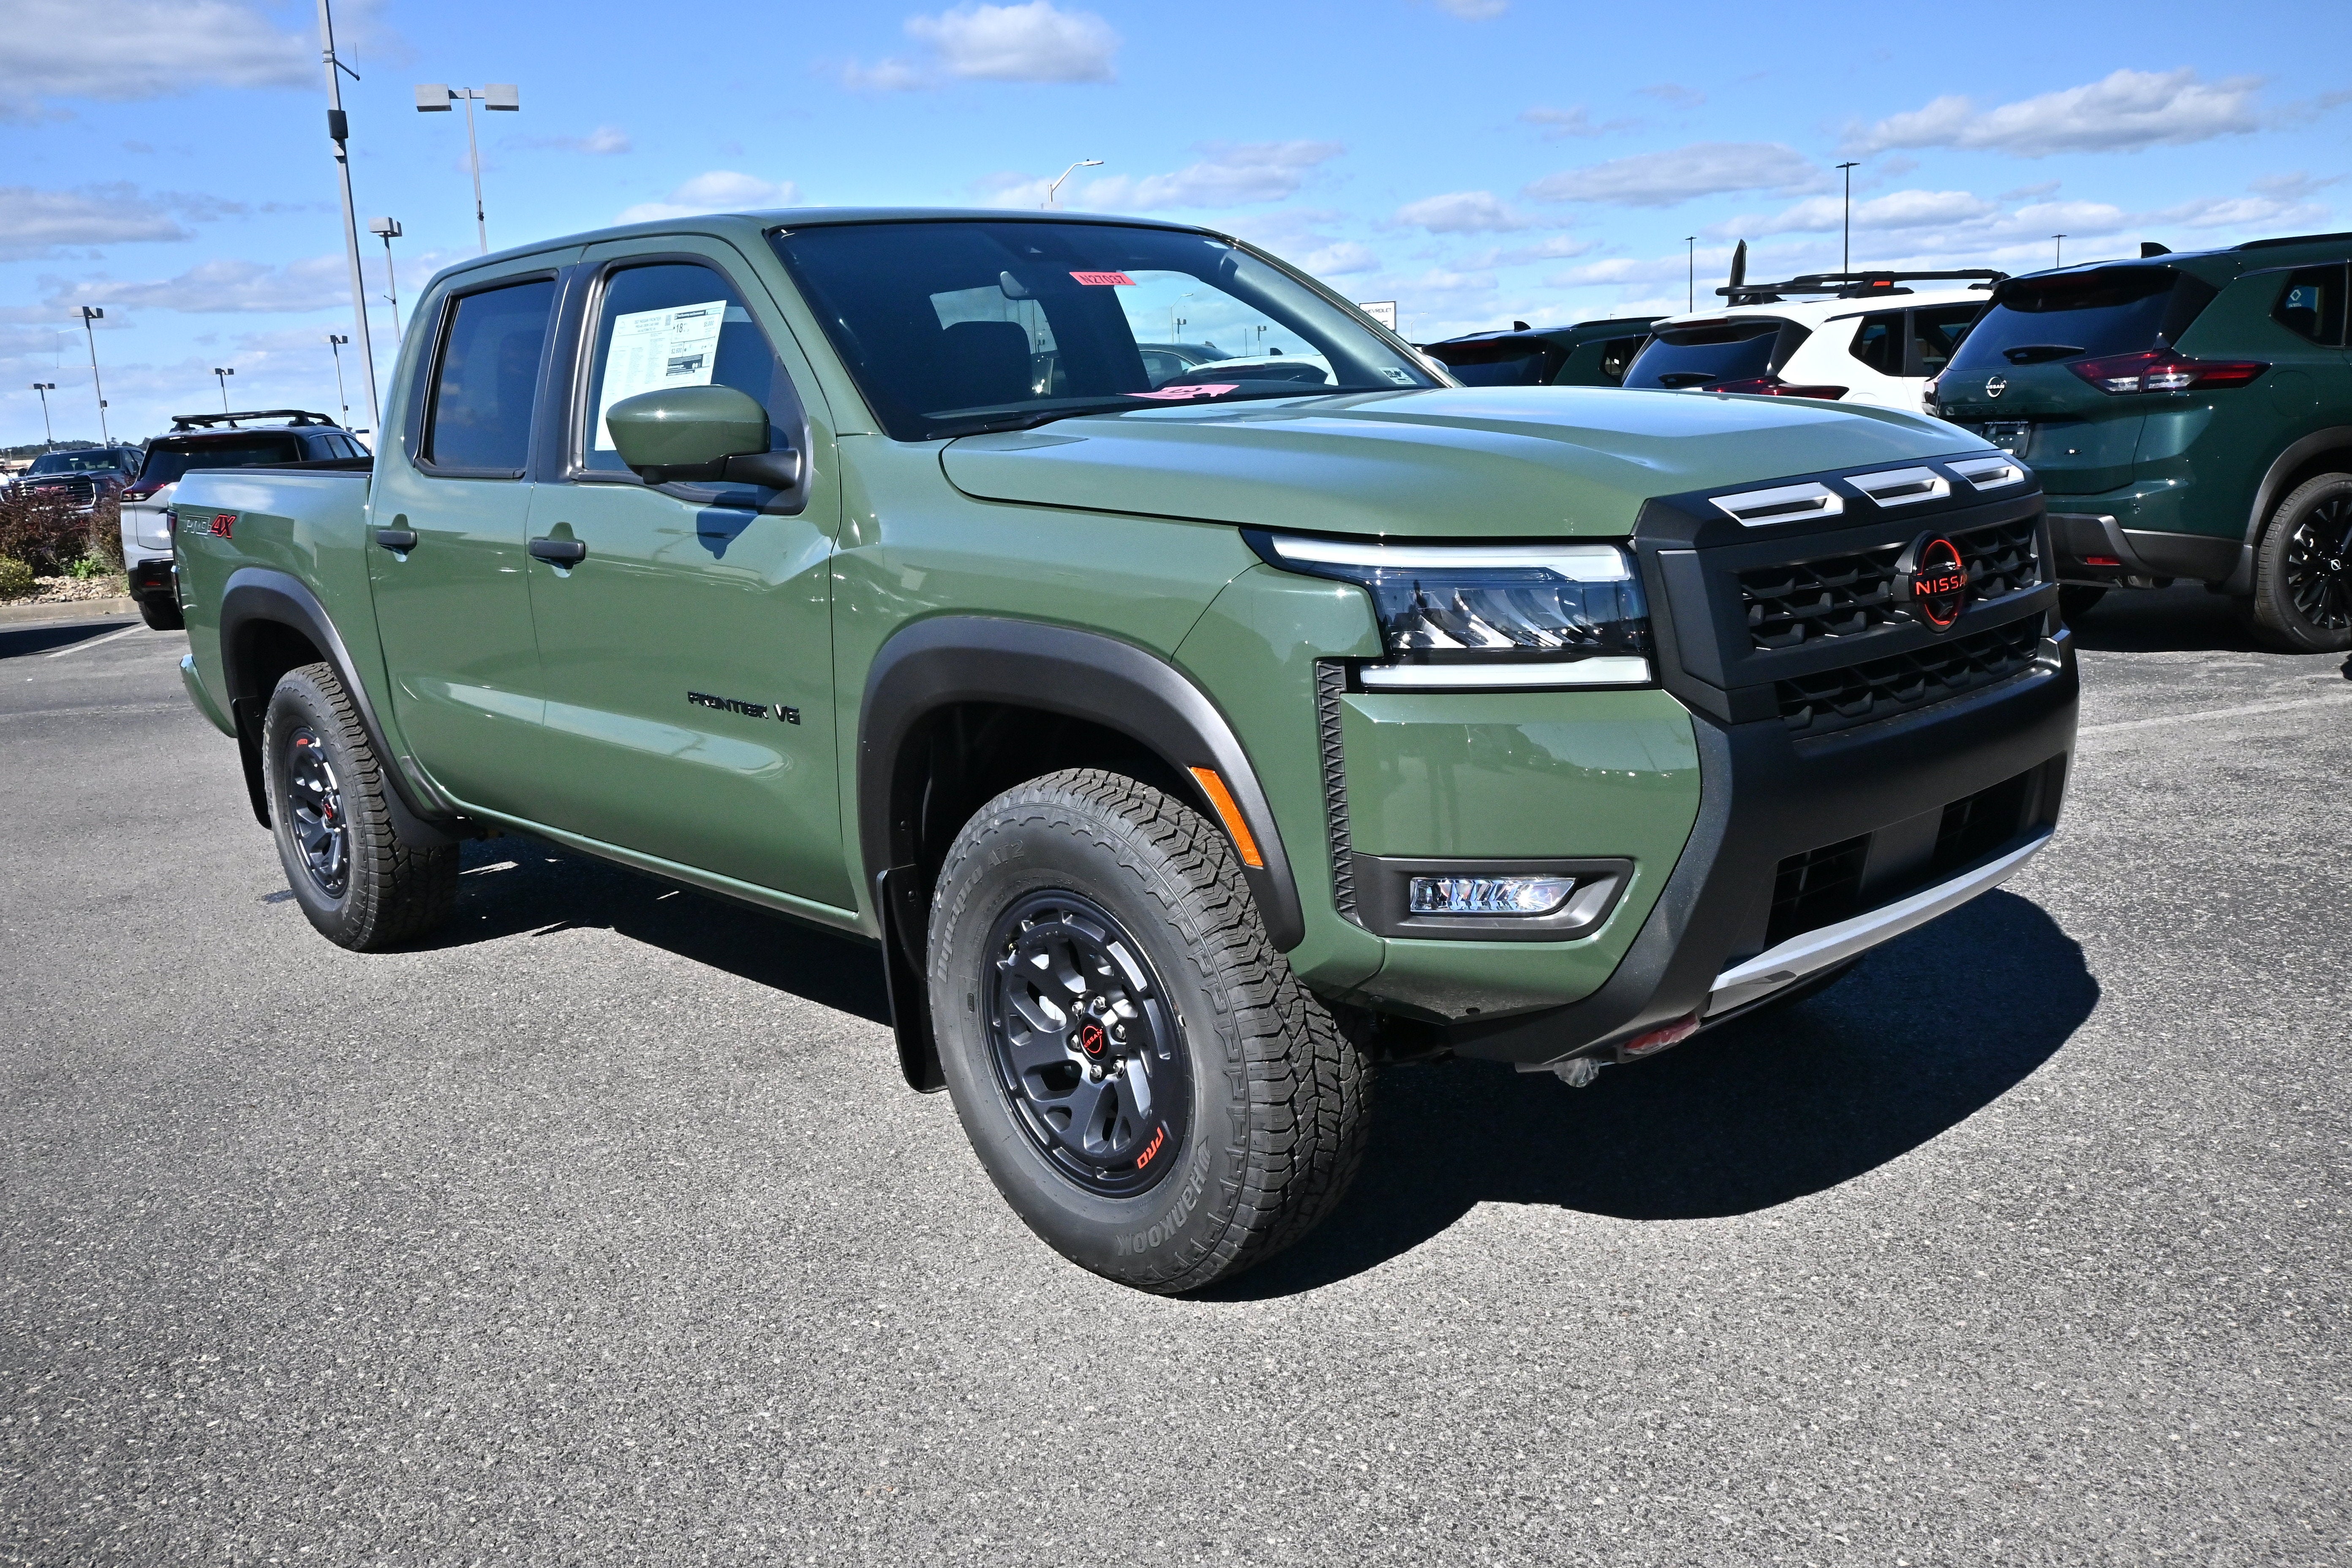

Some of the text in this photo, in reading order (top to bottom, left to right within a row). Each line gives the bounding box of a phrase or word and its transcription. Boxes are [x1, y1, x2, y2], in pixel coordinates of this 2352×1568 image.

[1078, 275, 1126, 283] N27037
[676, 323, 683, 333] 18
[1916, 575, 1967, 595] NISSA
[687, 691, 800, 725] FRONTIER V6
[937, 865, 983, 983] Dynapro
[1084, 1028, 1102, 1048] NISSAN
[1137, 1126, 1164, 1169] PRO
